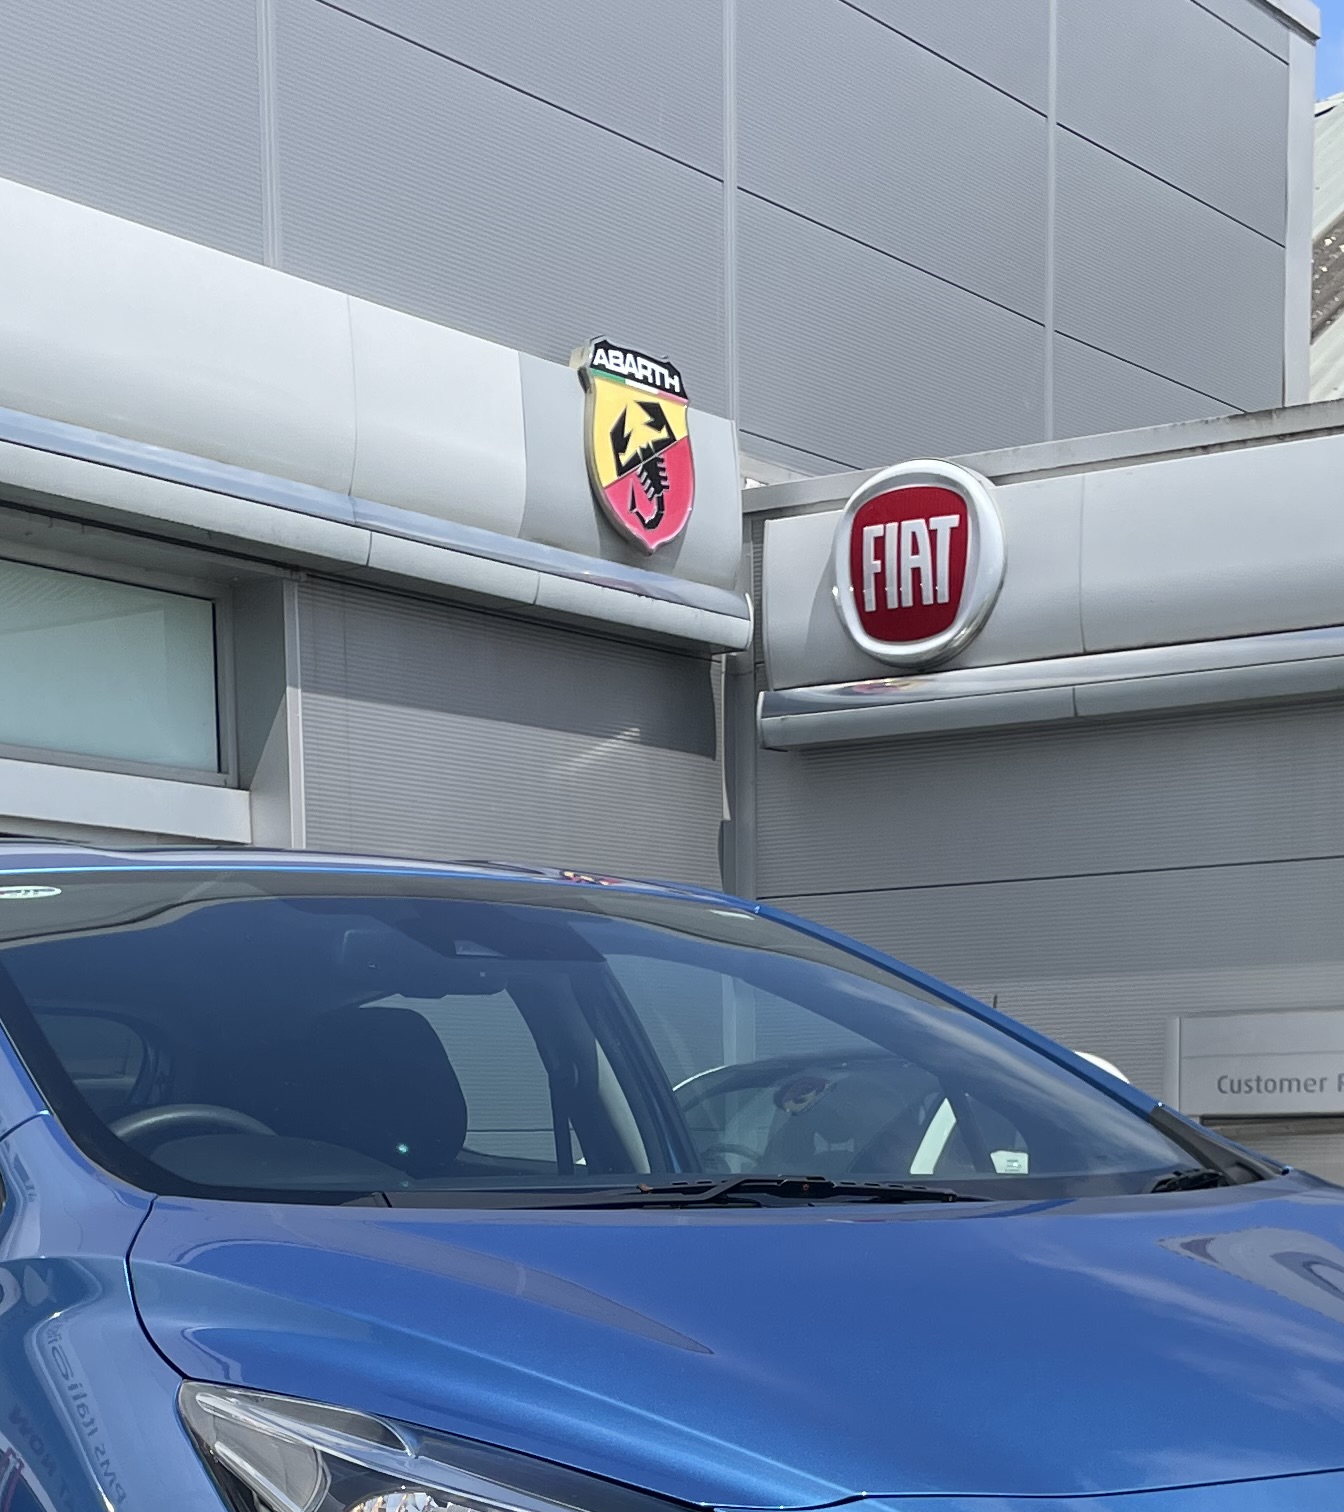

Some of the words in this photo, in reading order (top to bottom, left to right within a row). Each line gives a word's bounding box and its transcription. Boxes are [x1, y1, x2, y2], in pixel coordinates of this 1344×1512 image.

[592, 347, 681, 393] ABARTH
[861, 513, 961, 613] FIAT
[1216, 1073, 1328, 1095] Customer
